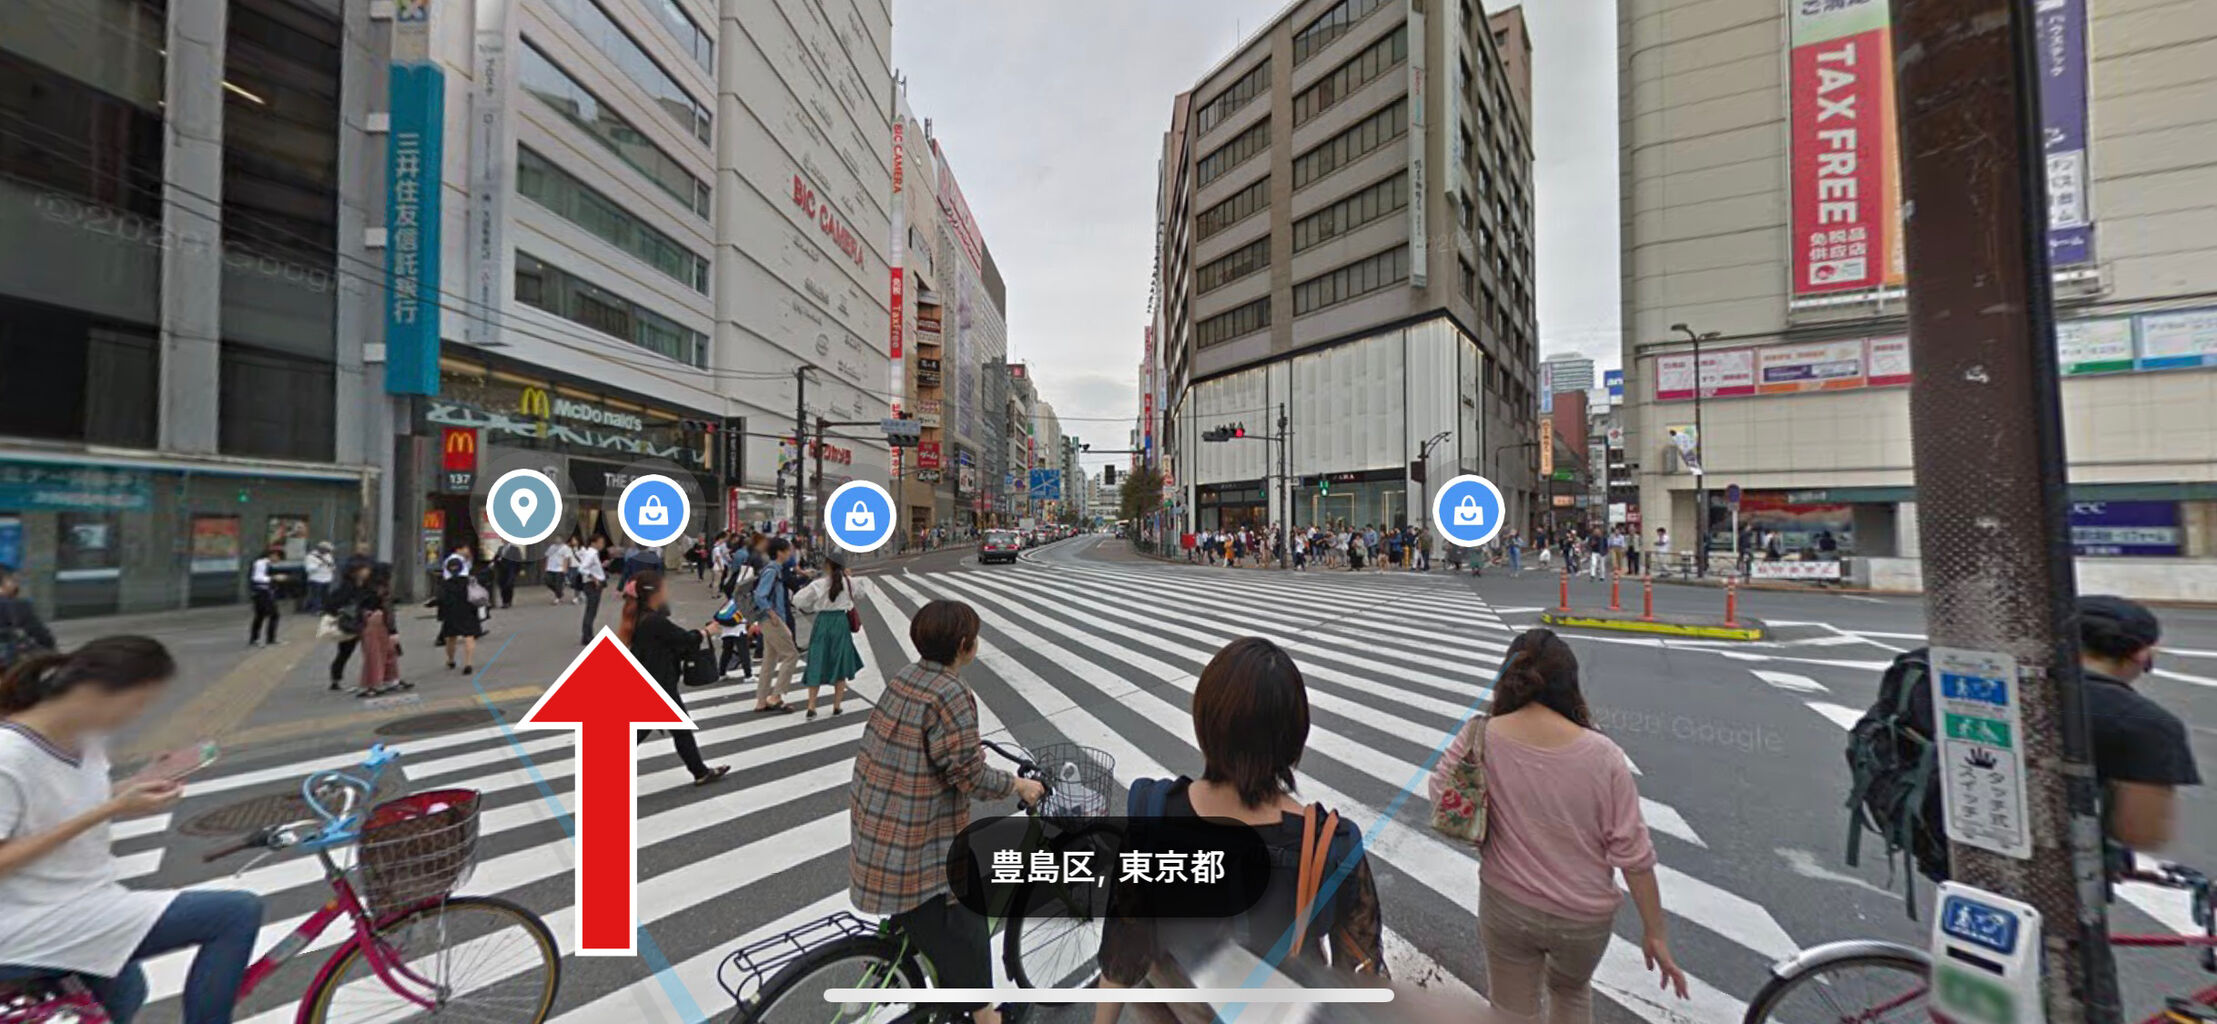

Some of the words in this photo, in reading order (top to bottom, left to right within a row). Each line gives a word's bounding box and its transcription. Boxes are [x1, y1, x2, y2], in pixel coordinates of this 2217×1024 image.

[1817, 42, 1857, 124] TAX
[1817, 128, 1857, 225] FREE
[394, 131, 421, 325] 三井住友信託銀行
[793, 173, 816, 220] BIC
[819, 204, 865, 271] CAMERA
[554, 399, 643, 431] McDonald's
[603, 472, 627, 488] THE
